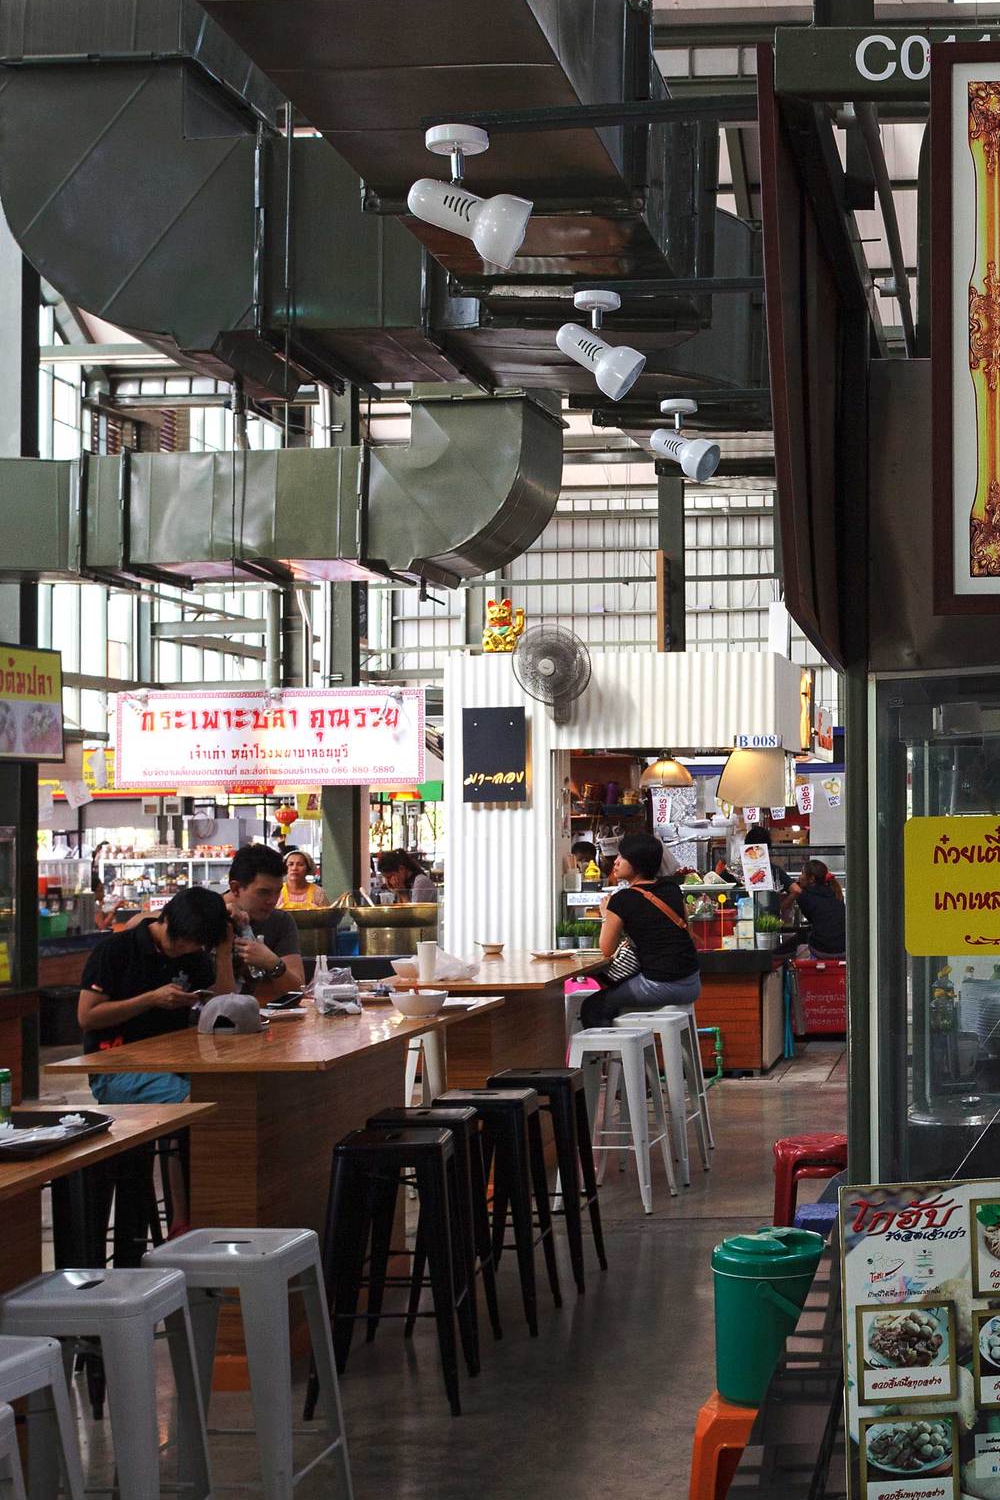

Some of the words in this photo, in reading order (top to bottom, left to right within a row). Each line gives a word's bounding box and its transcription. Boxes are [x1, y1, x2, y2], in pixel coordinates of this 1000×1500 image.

[141, 708, 297, 731] กระเพาะปลา
[310, 707, 400, 742] คุณรวย
[190, 744, 226, 760] เจ้าเก่า
[739, 736, 748, 747] B
[753, 736, 776, 747] 008
[657, 798, 667, 823] Sales
[801, 786, 812, 811] Sales
[850, 1194, 963, 1236] โกฮับ
